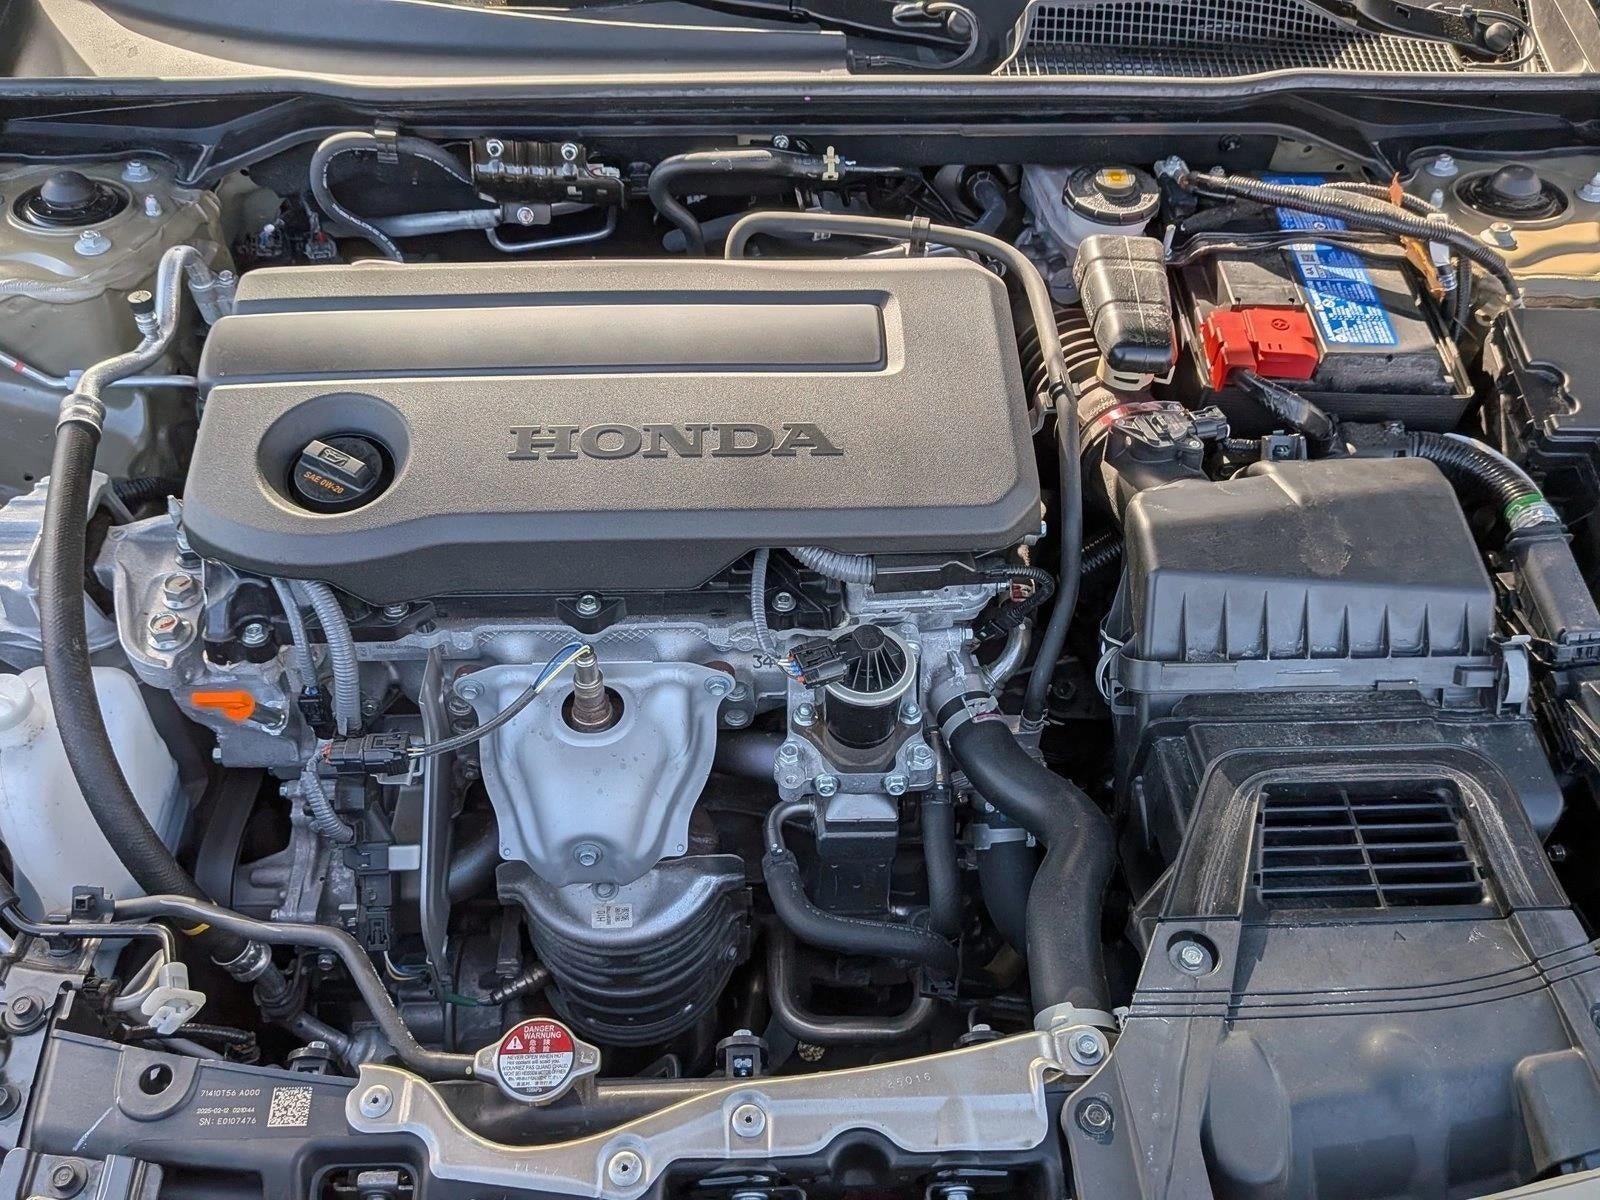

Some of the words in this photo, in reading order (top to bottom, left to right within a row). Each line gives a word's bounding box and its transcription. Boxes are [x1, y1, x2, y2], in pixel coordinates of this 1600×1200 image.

[508, 422, 844, 460] HONDA
[303, 471, 322, 483] SAE
[320, 480, 344, 494] 0W-20
[524, 1025, 555, 1033] DANGER
[523, 1031, 562, 1040] WARNUNG
[200, 1089, 237, 1097] 71410T56
[199, 1117, 215, 1126] SN:
[217, 1117, 257, 1125] E0107476
